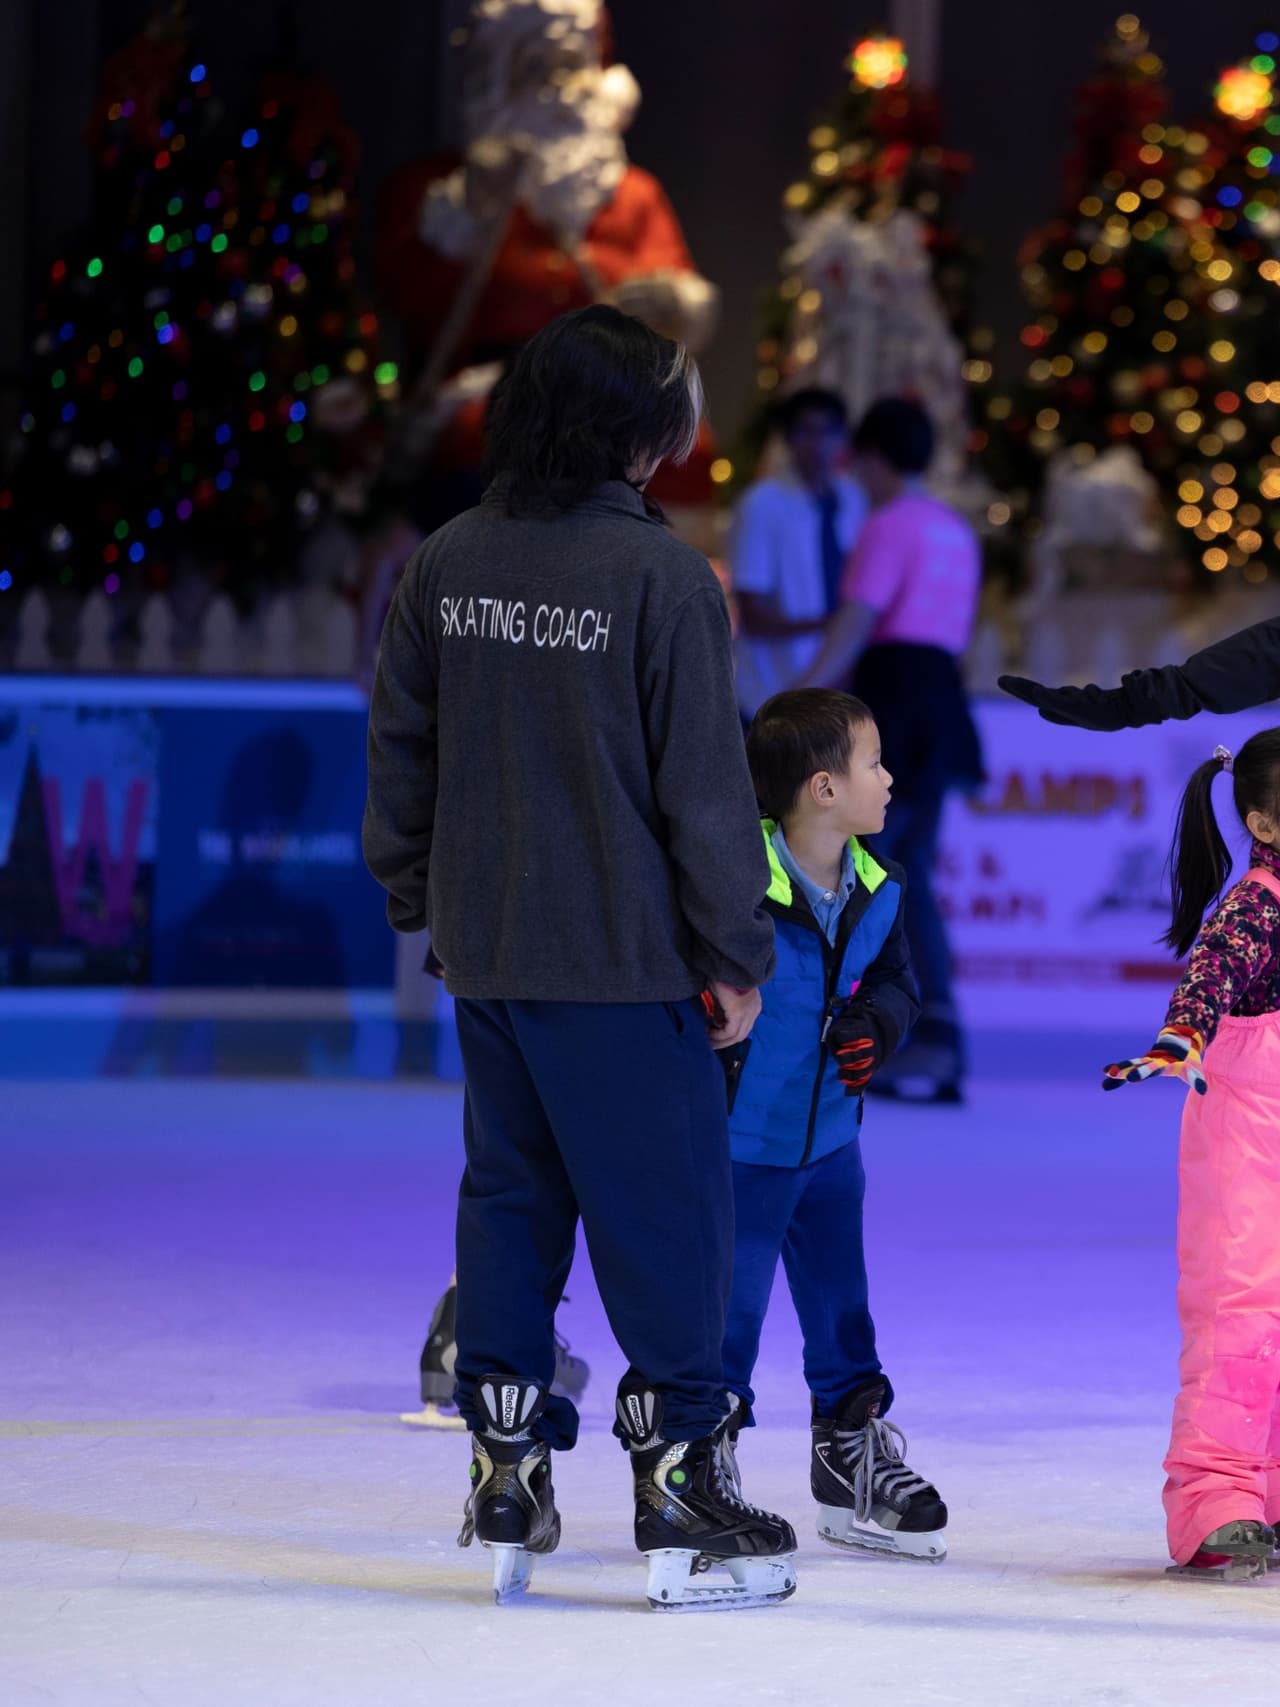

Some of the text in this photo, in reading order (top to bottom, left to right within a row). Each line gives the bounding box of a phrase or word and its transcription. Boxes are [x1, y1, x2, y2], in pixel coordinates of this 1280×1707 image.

[440, 597, 612, 652] SKATING COACH
[503, 1387, 516, 1426] Reebok
